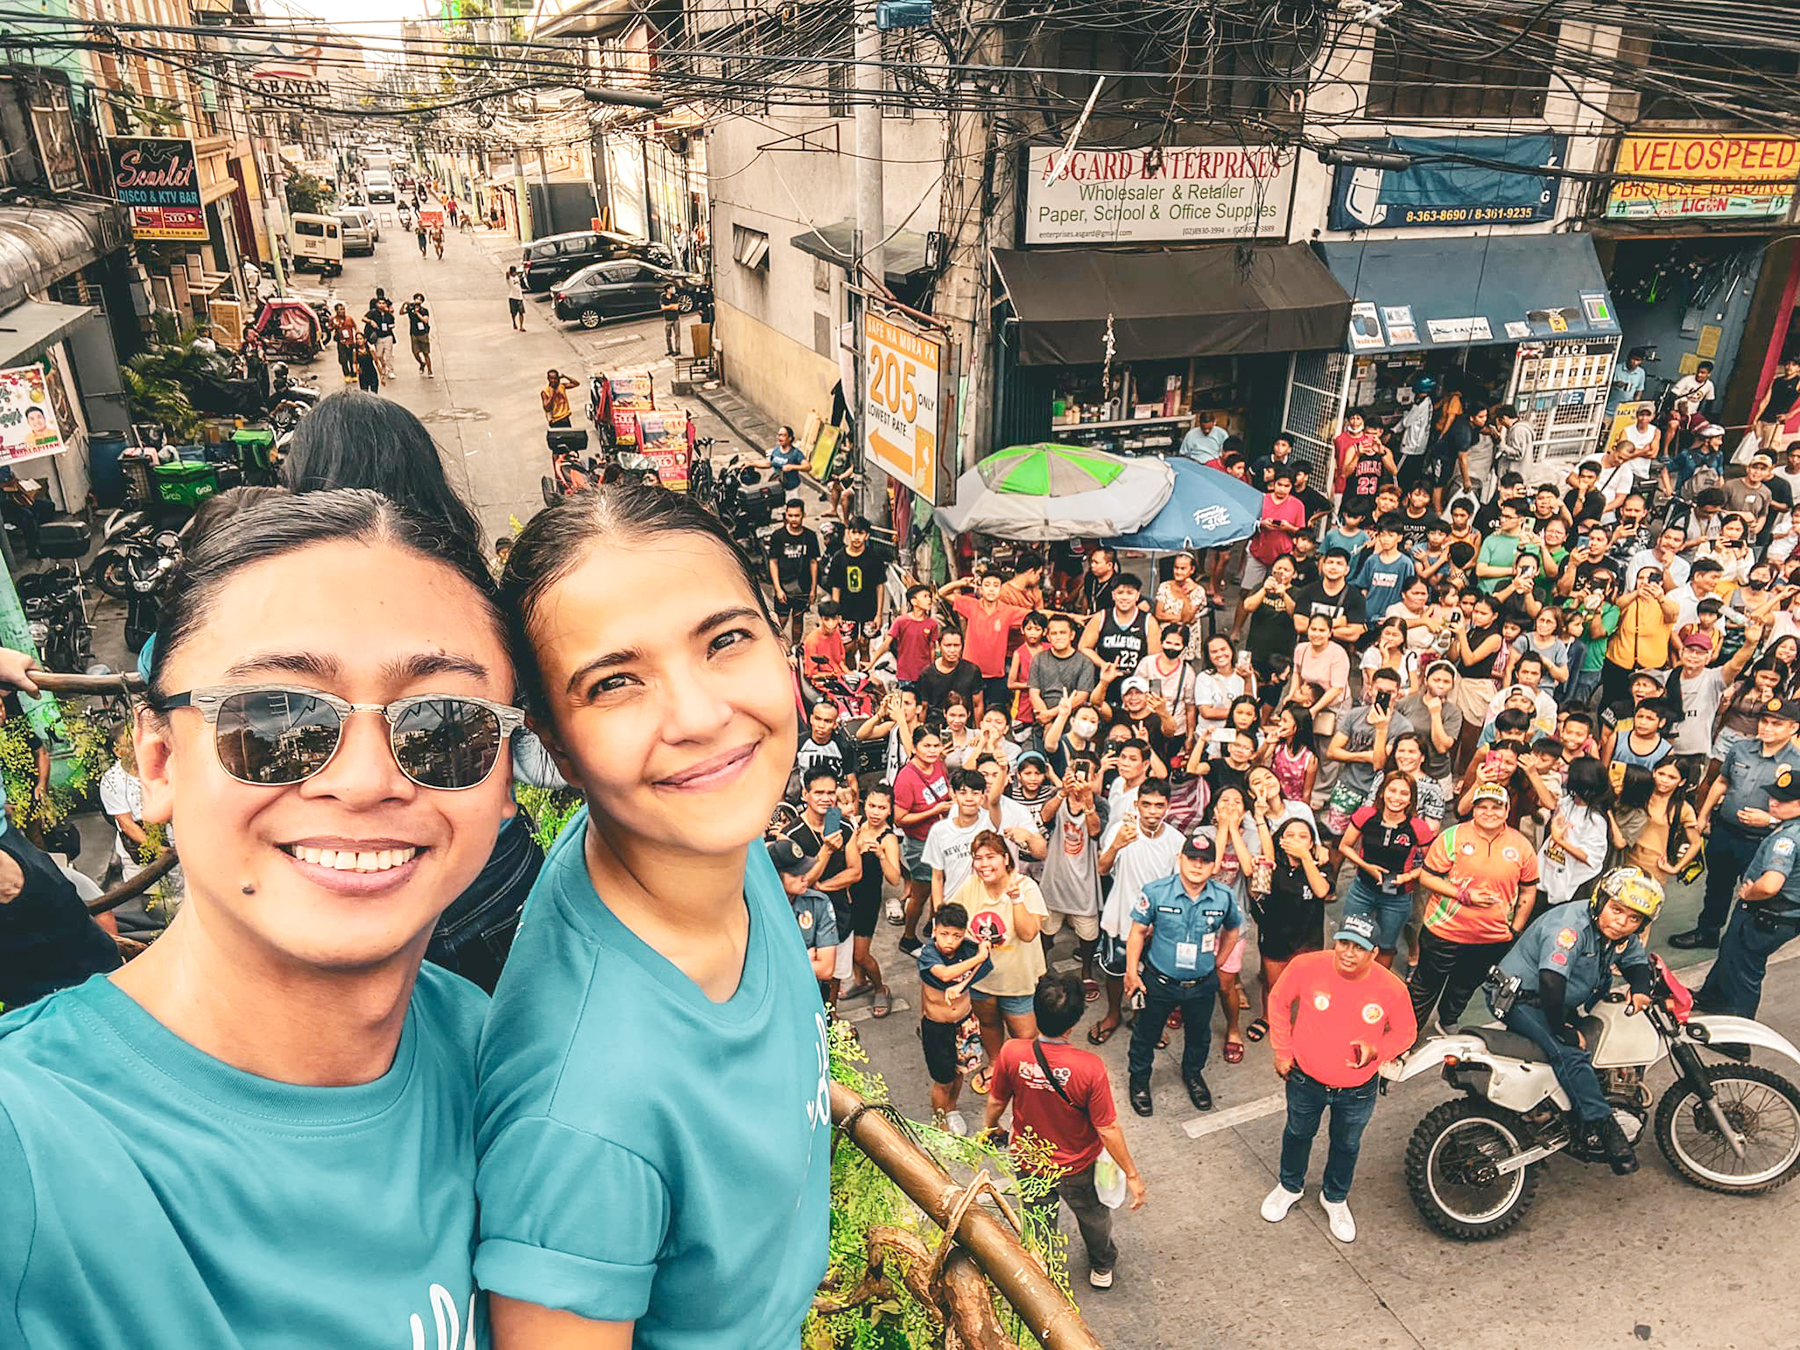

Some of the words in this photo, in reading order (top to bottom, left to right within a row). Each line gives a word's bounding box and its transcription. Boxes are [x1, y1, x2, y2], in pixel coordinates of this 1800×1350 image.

[1632, 139, 1797, 171] VELOSPEED
[116, 150, 195, 188] Scarlet
[118, 190, 146, 203] DISCO
[149, 191, 157, 203] &
[158, 191, 177, 203] KTV
[179, 191, 198, 204] BAR
[1079, 184, 1165, 201] Wholesaler
[1172, 184, 1183, 200] &
[1188, 183, 1245, 199] Retailer
[1039, 205, 1088, 225] Paper,
[1094, 204, 1145, 220] School
[1150, 204, 1160, 220] &
[1169, 203, 1211, 219] Office
[1216, 203, 1277, 221] Supples
[1406, 208, 1466, 222] 8-363-8690
[867, 318, 885, 340] SAFE
[886, 326, 898, 346] NA
[900, 333, 922, 357] MURA
[924, 347, 936, 364] PA
[870, 344, 918, 424] 205
[917, 393, 936, 412] ONLY
[867, 402, 891, 427] LOWEST
[196, 484, 212, 495] Grab
[1357, 477, 1378, 494] 23
[1120, 650, 1138, 668] 23
[943, 845, 961, 857] NEW
